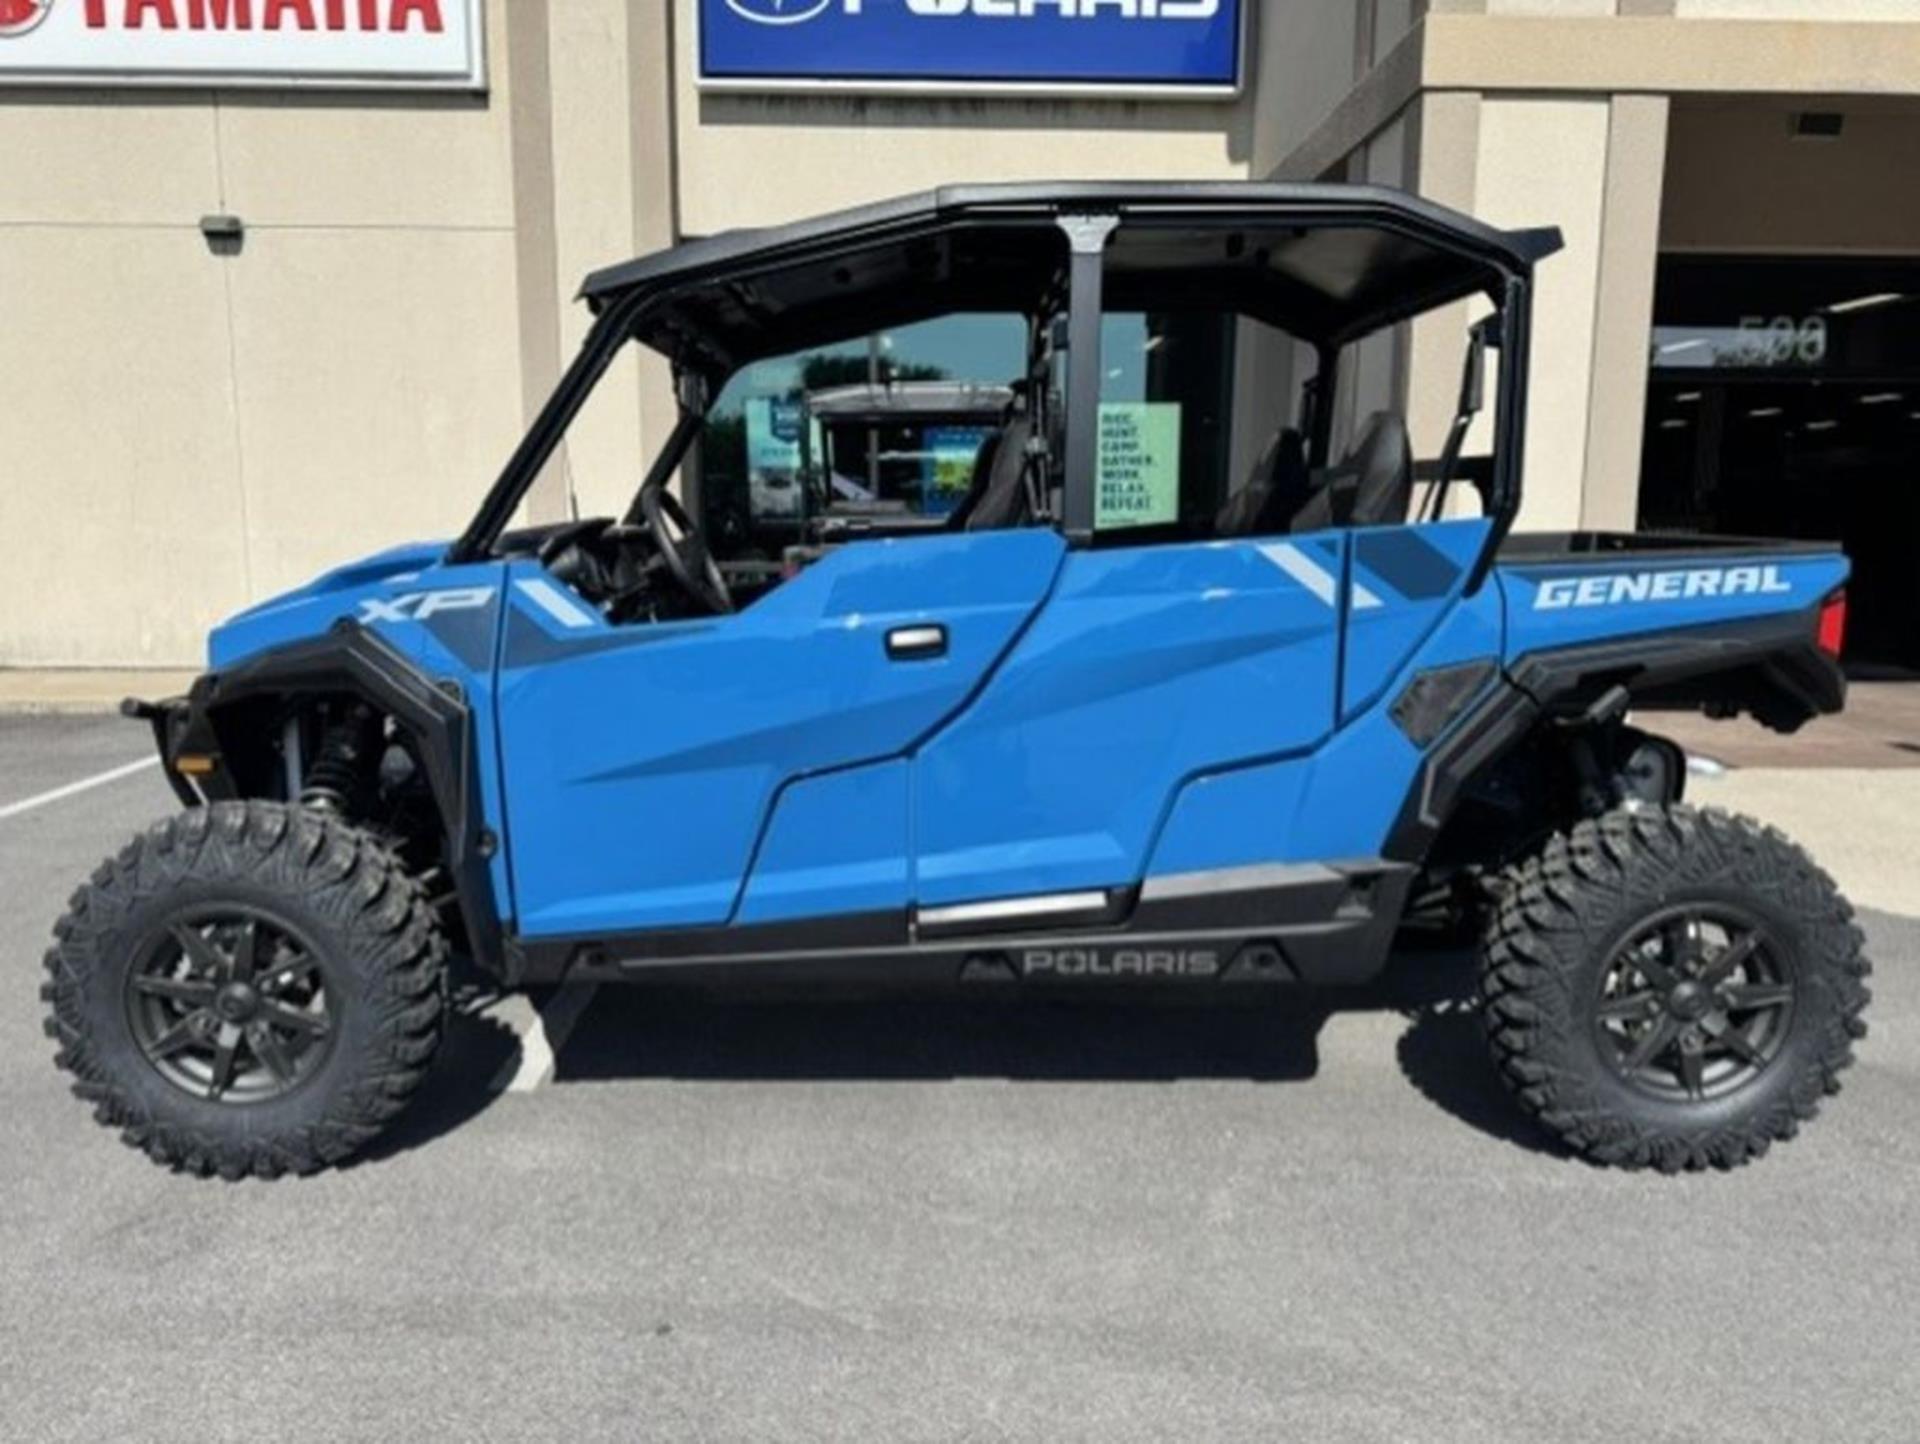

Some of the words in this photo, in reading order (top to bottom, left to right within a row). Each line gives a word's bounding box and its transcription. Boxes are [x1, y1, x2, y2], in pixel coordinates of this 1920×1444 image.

[357, 586, 496, 625] XP
[1533, 565, 1791, 611] GENERAL
[1022, 949, 1219, 977] POLARIS
